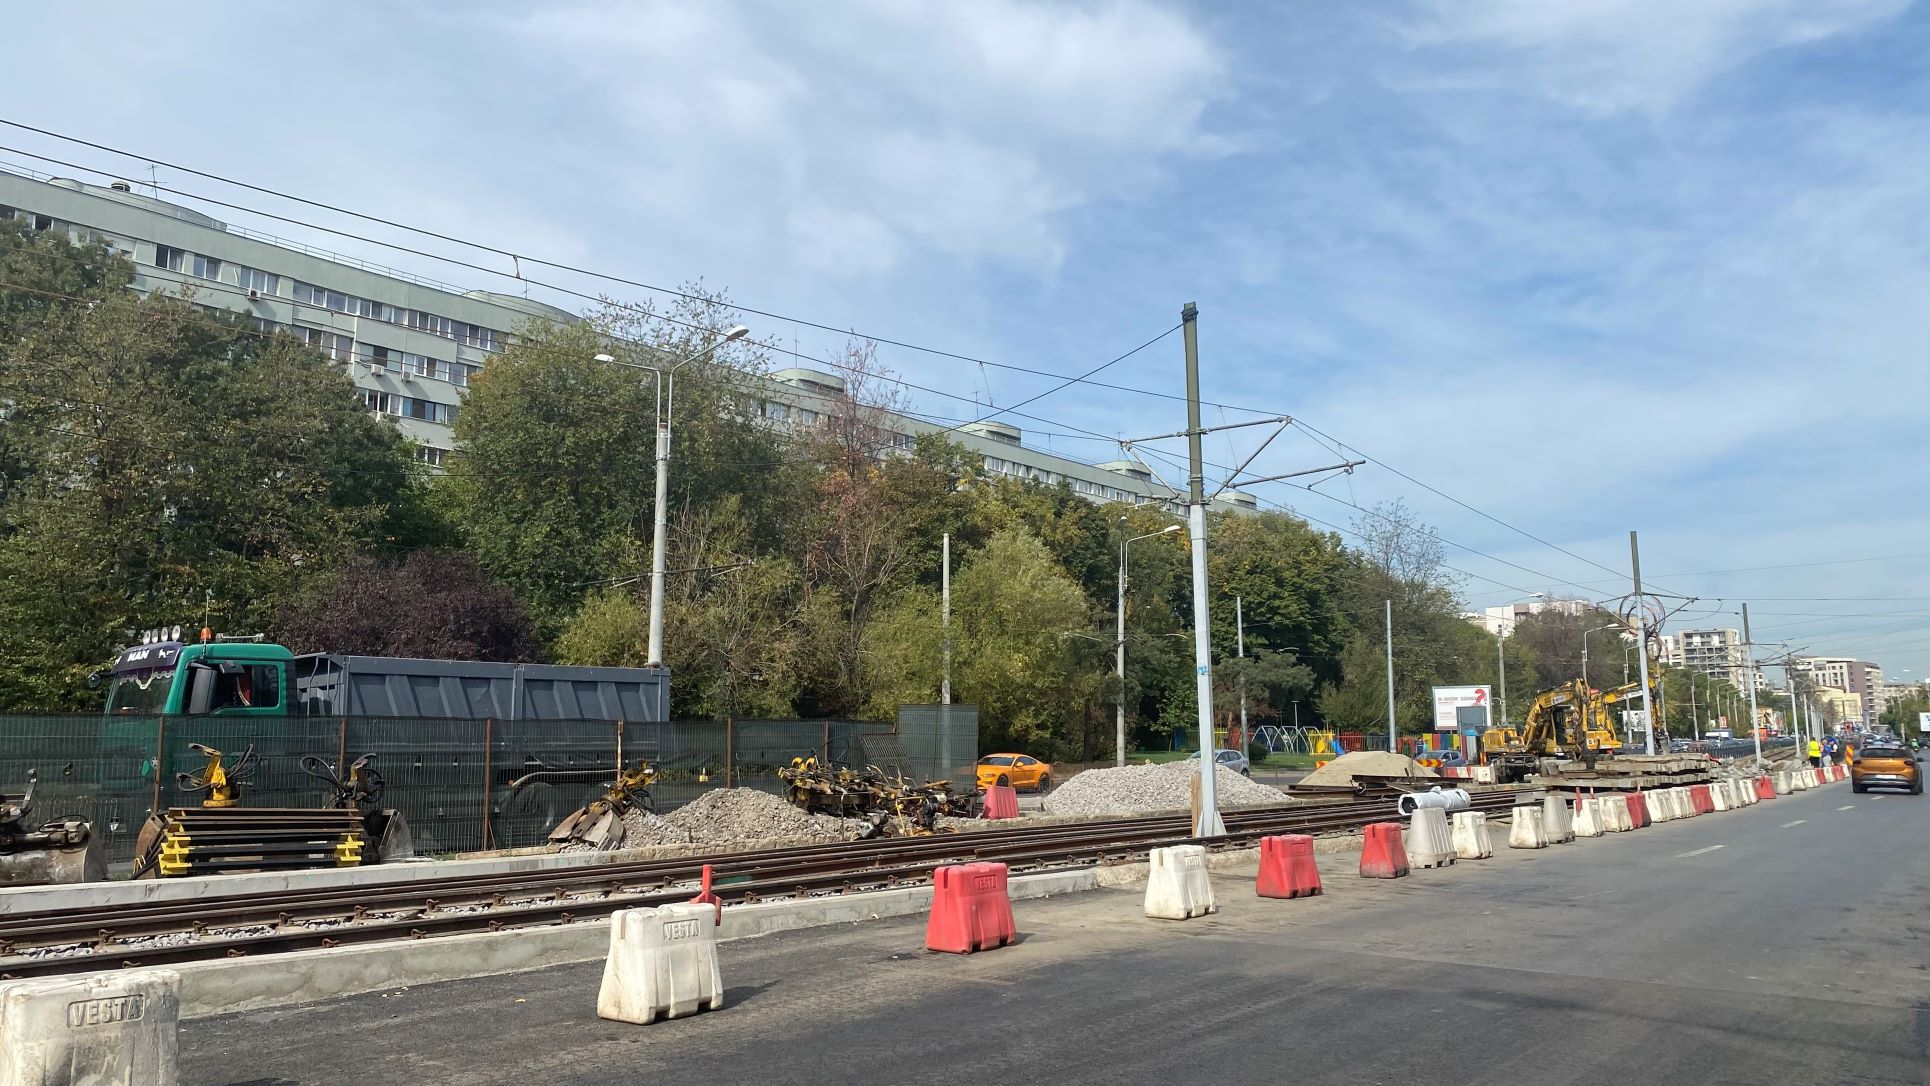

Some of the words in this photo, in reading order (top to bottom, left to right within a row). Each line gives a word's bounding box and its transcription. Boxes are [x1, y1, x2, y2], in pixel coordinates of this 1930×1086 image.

[127, 649, 150, 662] MAN
[664, 920, 700, 940] VESTA
[72, 996, 143, 1026] VESTA
